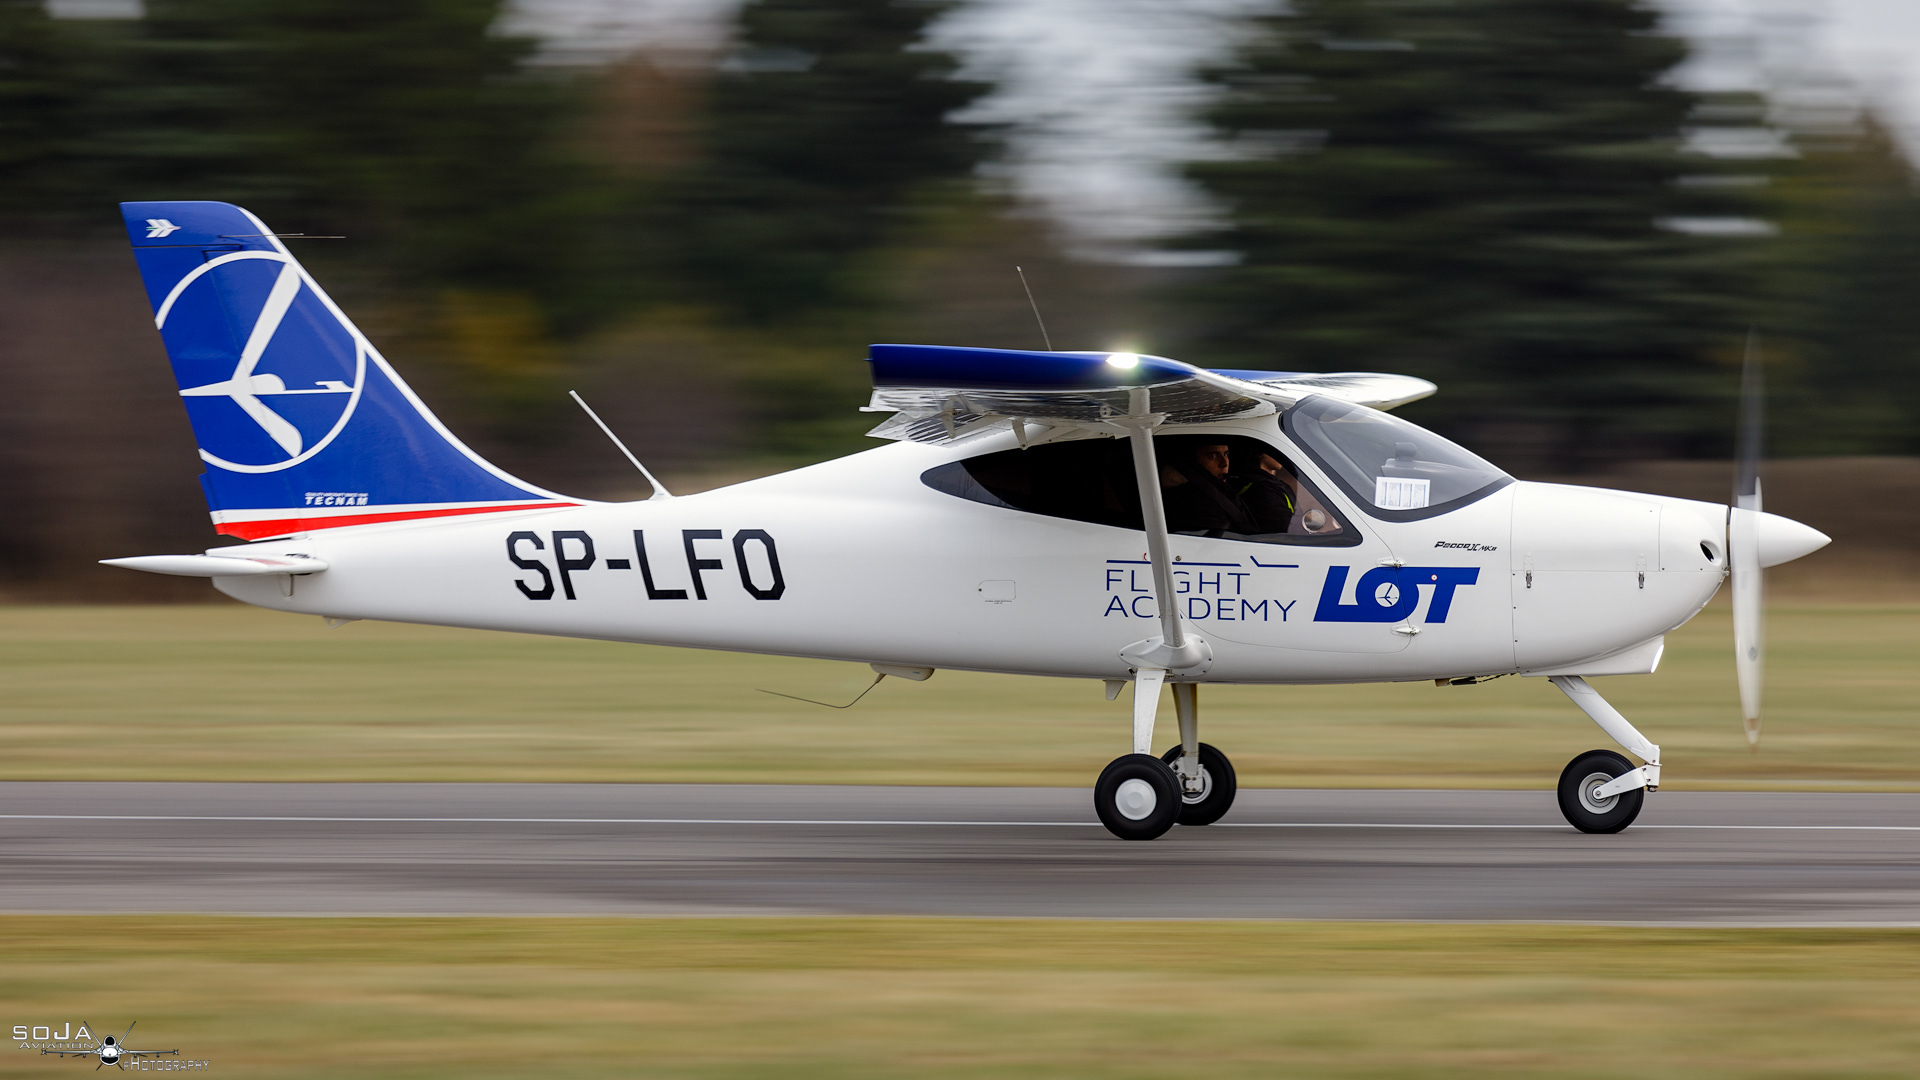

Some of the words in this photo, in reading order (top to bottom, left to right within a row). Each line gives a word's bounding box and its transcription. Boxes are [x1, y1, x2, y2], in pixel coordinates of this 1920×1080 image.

[305, 496, 368, 505] TECNAM
[506, 529, 785, 600] SP-LFO
[1106, 569, 1250, 594] FLGHT
[1313, 566, 1480, 623] LOT
[1104, 595, 1297, 621] ACDEMY
